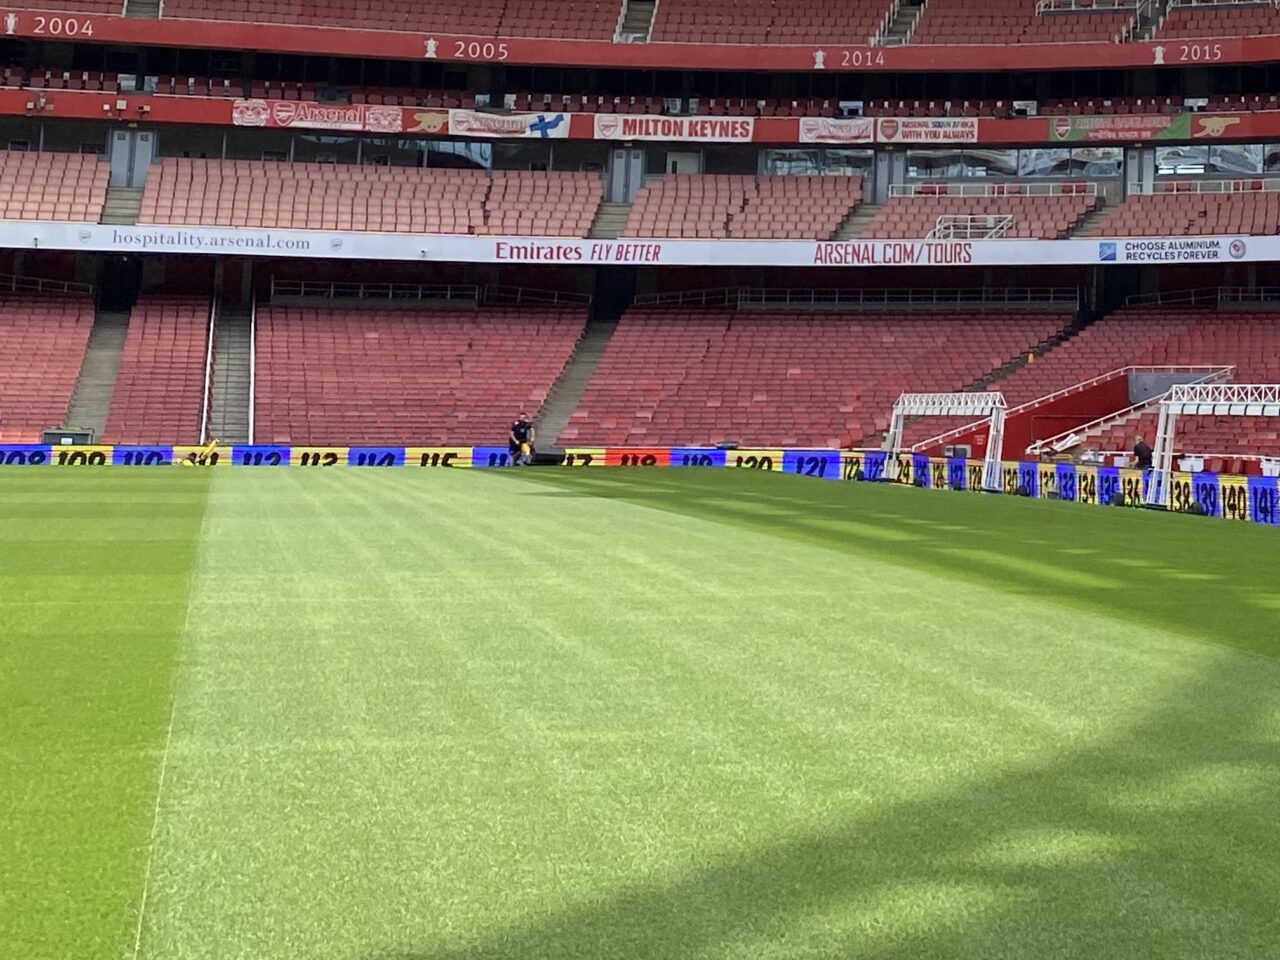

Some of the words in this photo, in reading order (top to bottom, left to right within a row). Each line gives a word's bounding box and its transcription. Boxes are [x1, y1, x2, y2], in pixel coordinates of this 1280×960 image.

[32, 16, 95, 38] 2004
[453, 40, 509, 61] 2005
[841, 50, 885, 68] 2014
[1179, 44, 1222, 62] 2015
[295, 103, 363, 123] Arsenal
[622, 118, 684, 137] MILTON
[687, 120, 751, 138] KEYNES
[901, 130, 922, 140] WITH
[924, 130, 941, 140] YOU
[942, 130, 975, 140] ALWAYS
[112, 229, 311, 250] hospitality.arsenal.com
[1125, 242, 1167, 251] CHOOSE
[495, 242, 583, 262] Emirates
[590, 243, 613, 262] FLY
[614, 243, 661, 262] BETTER
[813, 242, 973, 266] ARSENAL.COM/TOURS
[1125, 251, 1176, 261] RECYCLES
[796, 456, 829, 479] 121
[1221, 484, 1246, 521] 140
